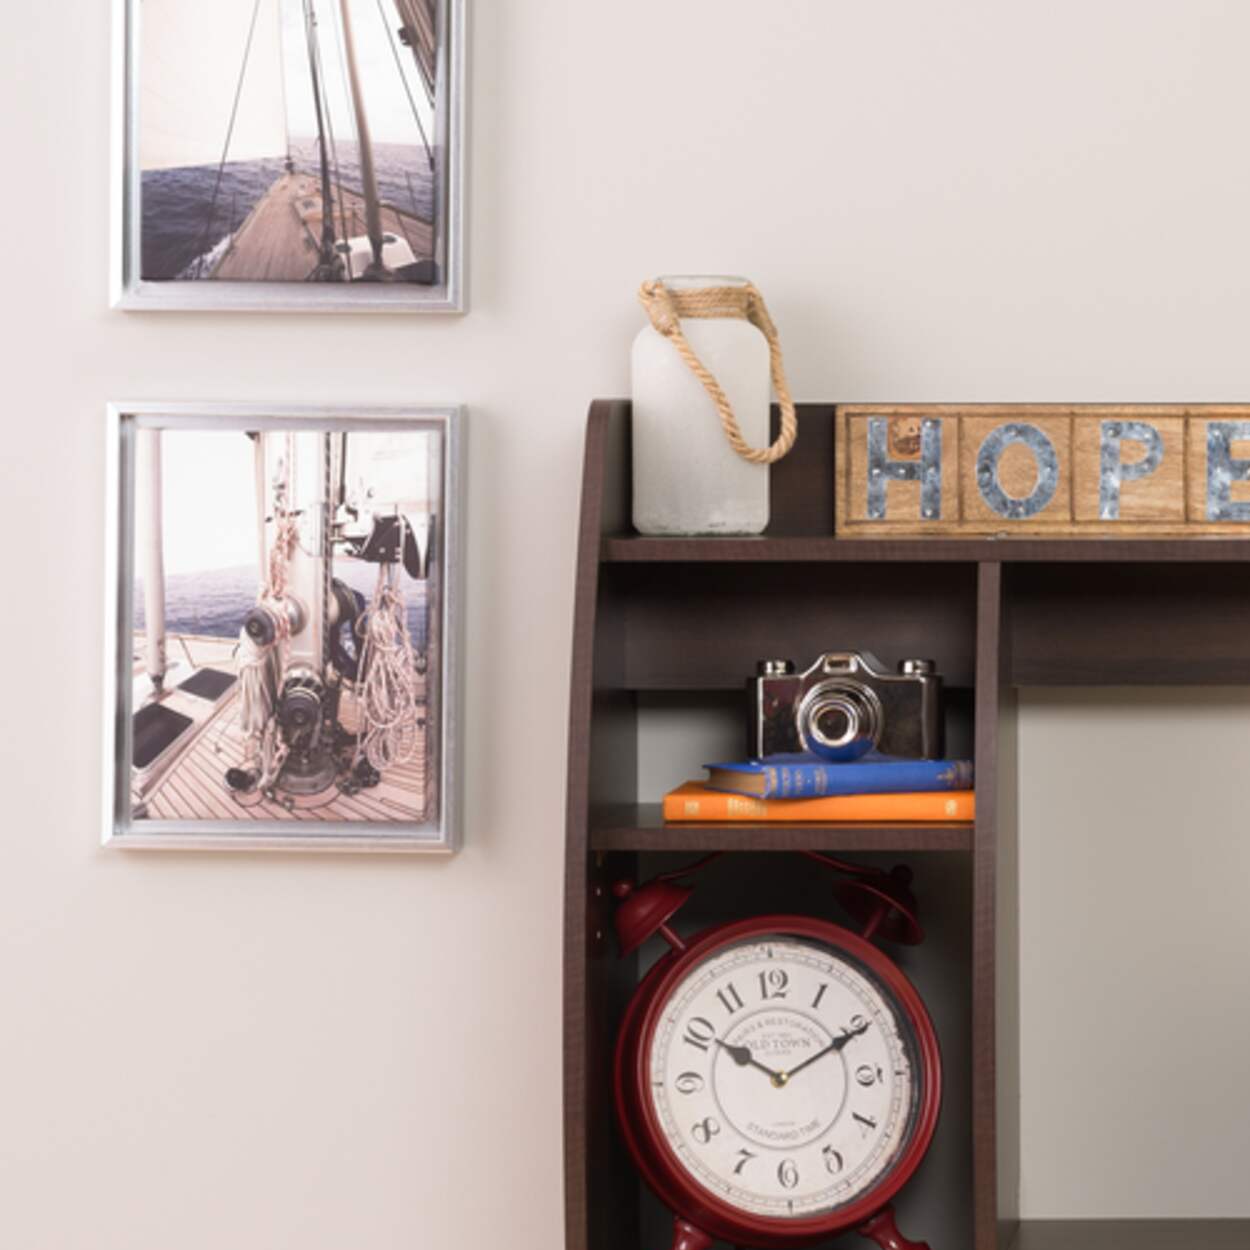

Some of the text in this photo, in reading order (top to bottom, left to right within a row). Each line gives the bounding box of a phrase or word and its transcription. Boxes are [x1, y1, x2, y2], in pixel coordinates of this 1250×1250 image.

[716, 982, 744, 1014] 11
[758, 968, 788, 1000] 12
[811, 983, 828, 1009] 1
[682, 1016, 716, 1052] 10
[772, 1038, 811, 1049] TOWN
[675, 1070, 704, 1095] 9
[691, 1116, 720, 1144] 8
[733, 1149, 755, 1175] 7
[777, 1159, 799, 1189] 6
[821, 1145, 843, 1175] 5
